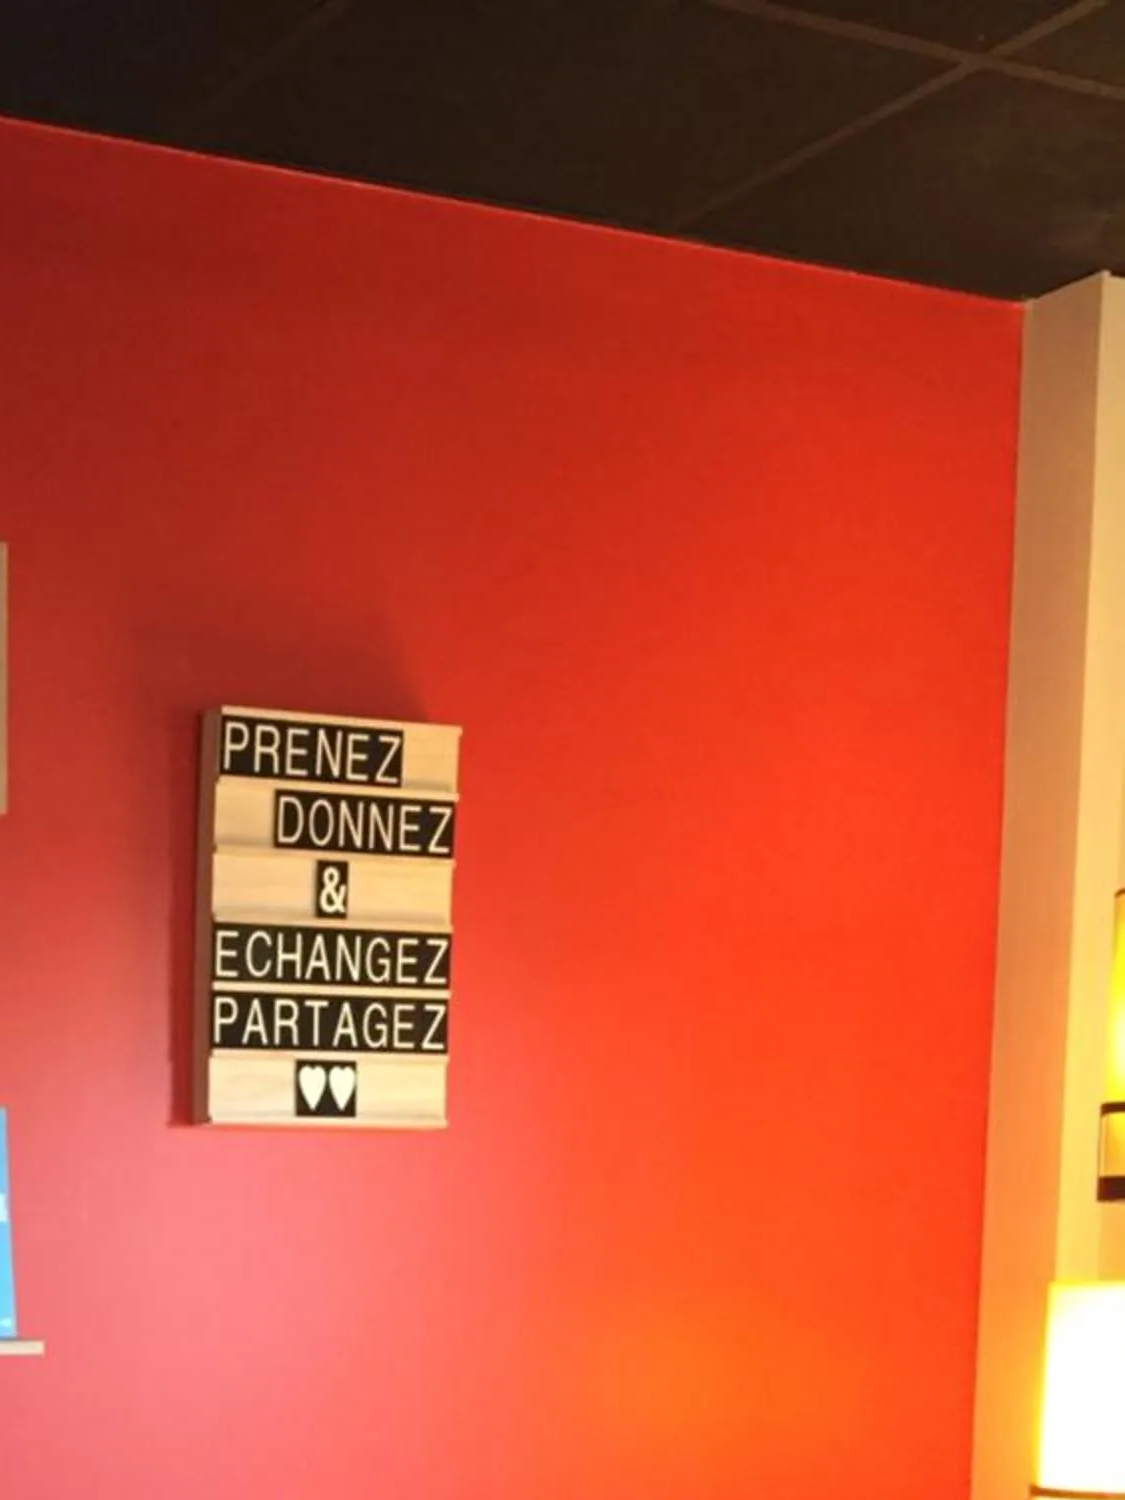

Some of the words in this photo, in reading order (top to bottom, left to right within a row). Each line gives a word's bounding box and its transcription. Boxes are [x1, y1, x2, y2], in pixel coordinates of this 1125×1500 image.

[222, 721, 401, 784] PRENEZ
[277, 796, 453, 855] DONNEZ
[319, 866, 347, 914] &
[215, 930, 450, 985] ECHANGEZ
[213, 996, 448, 1051] PARTAGEZ
